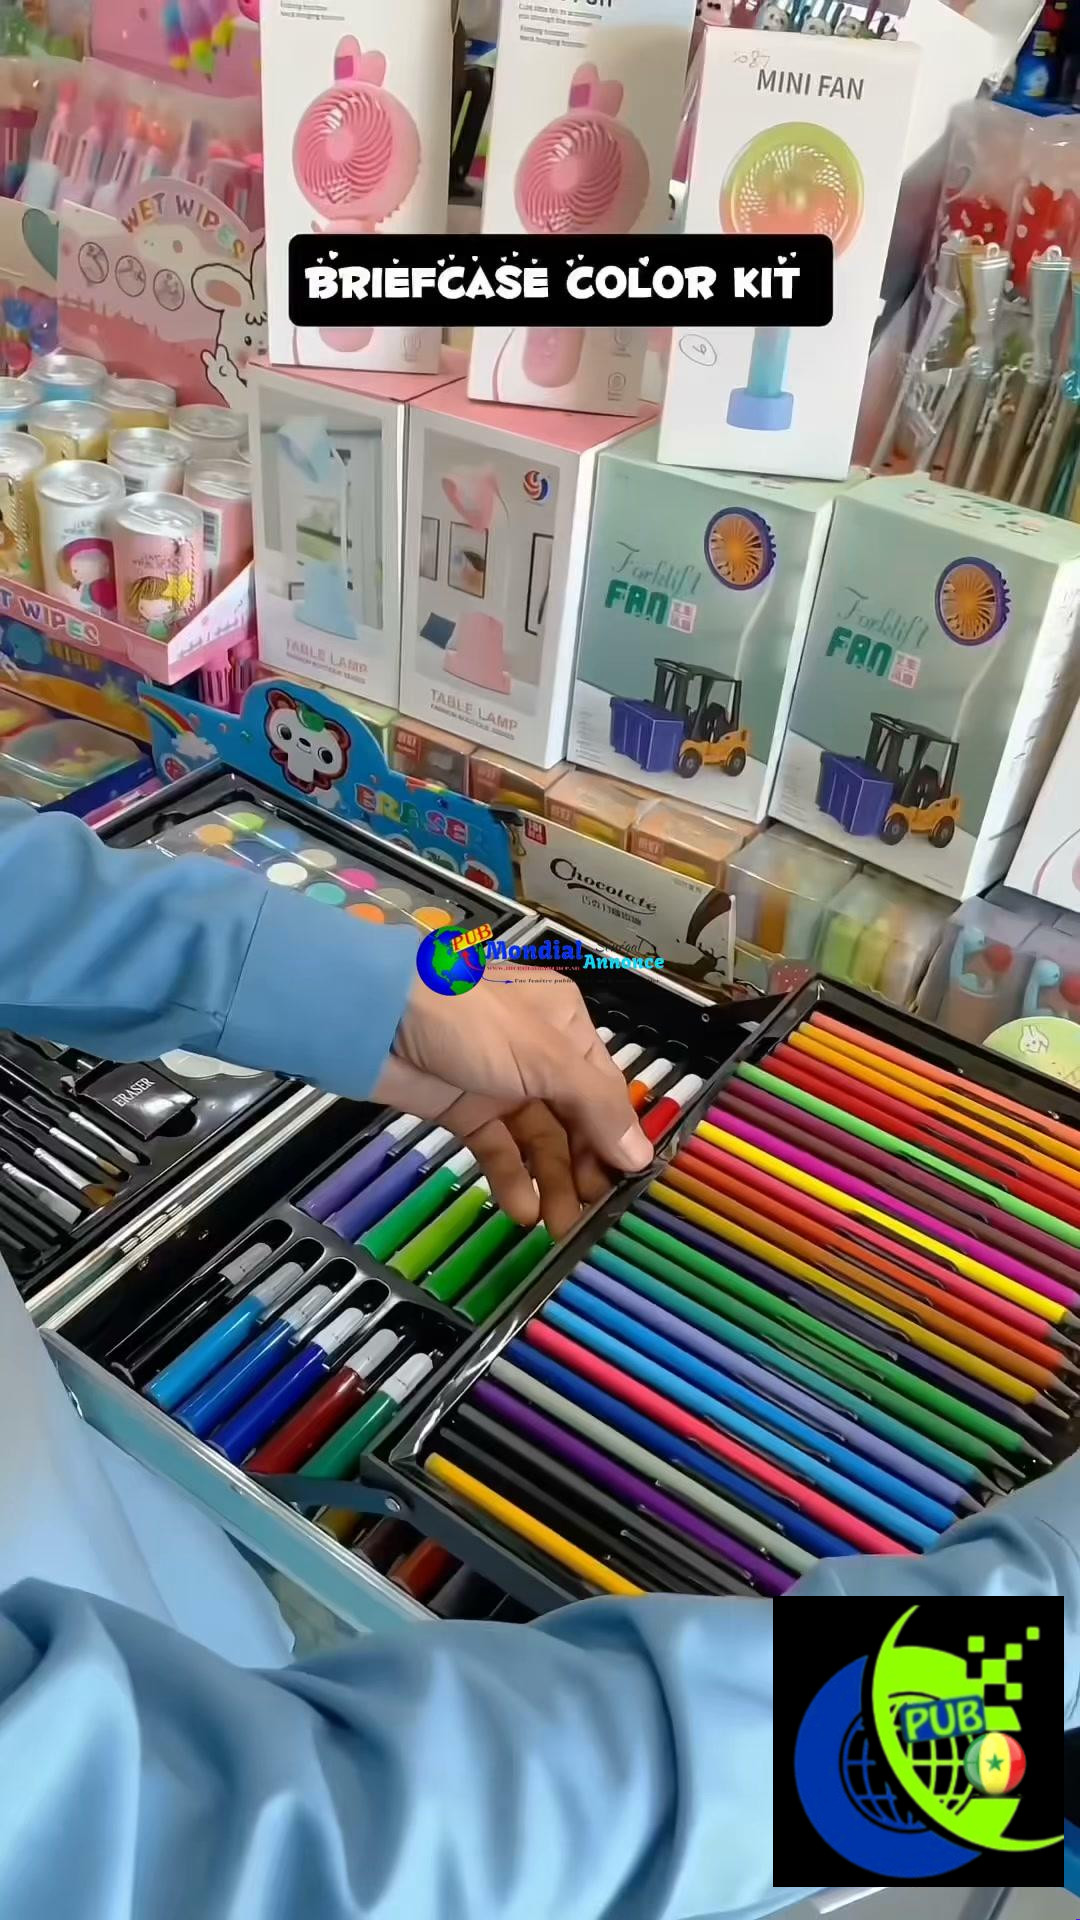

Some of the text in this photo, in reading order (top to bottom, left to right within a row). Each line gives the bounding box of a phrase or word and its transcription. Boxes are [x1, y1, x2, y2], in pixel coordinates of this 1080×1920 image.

[756, 68, 865, 100] MINI FAN
[121, 193, 165, 233] WET
[604, 579, 669, 625] FAN
[285, 637, 326, 662] TABLE
[330, 649, 369, 673] LAMP
[825, 626, 893, 677] FAN
[430, 688, 473, 715] TABLE
[478, 706, 519, 732] LAMP
[550, 857, 657, 912] Chocolate
[111, 1077, 156, 1107] ERASER
